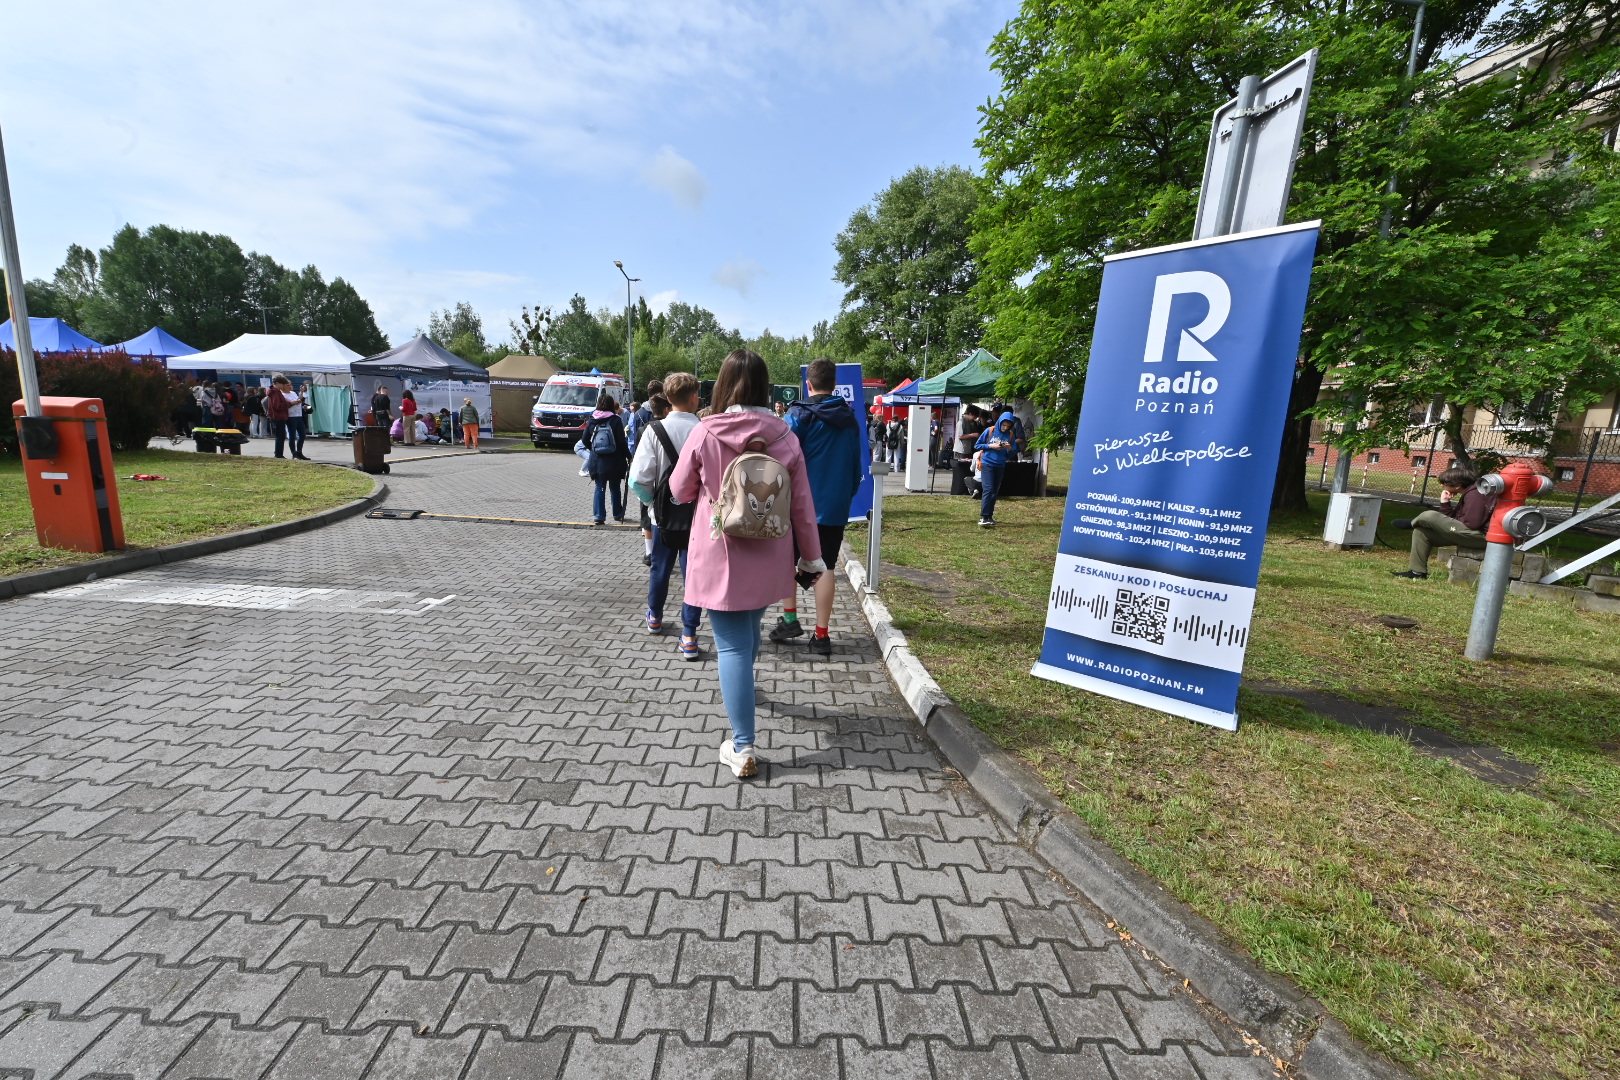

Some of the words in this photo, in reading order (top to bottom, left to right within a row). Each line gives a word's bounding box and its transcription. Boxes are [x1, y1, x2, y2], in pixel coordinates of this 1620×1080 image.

[1138, 370, 1219, 394] Radio
[1135, 398, 1214, 415] Poznań
[1093, 464, 1109, 475] w
[1116, 442, 1252, 470] Wielkopolsce
[1094, 430, 1173, 459] pierwsze
[1075, 502, 1107, 513] OSTRÓW
[1107, 506, 1131, 517] WLKP.
[1134, 511, 1152, 521] 91,1
[1152, 513, 1173, 523] MHZ
[1178, 517, 1205, 529] KONIN
[1209, 522, 1230, 532] 91,9
[1230, 524, 1253, 534] MHZ
[1087, 492, 1118, 502] POZNAŃ
[1121, 497, 1141, 507] 100,9
[1142, 499, 1161, 509] MHZ
[1167, 502, 1196, 513] KALISZ
[1199, 507, 1219, 518] 91,1
[1219, 510, 1242, 519] MHZ
[1073, 525, 1096, 536] NOWY
[1096, 529, 1124, 541] TOMYŚL
[1128, 535, 1151, 546] 102,4
[1151, 538, 1171, 548] MHZ
[1175, 542, 1194, 553] PIŁA
[1198, 547, 1224, 558] 103,6
[1224, 550, 1247, 560] MHZ
[1080, 515, 1113, 526] GNIEZNO
[1116, 521, 1132, 531] 98,3
[1132, 523, 1152, 533] MHZ
[1157, 526, 1190, 539] LESZNO
[1193, 533, 1219, 545] 100,9
[1219, 536, 1241, 546] MHZ
[1074, 564, 1125, 583] ZESKANUJ
[1127, 575, 1150, 587] KOD
[1152, 580, 1157, 588] I
[1158, 581, 1228, 602] POSŁUCHAJ
[1067, 653, 1204, 695] WWW.RADIOPOZNAN.FM
